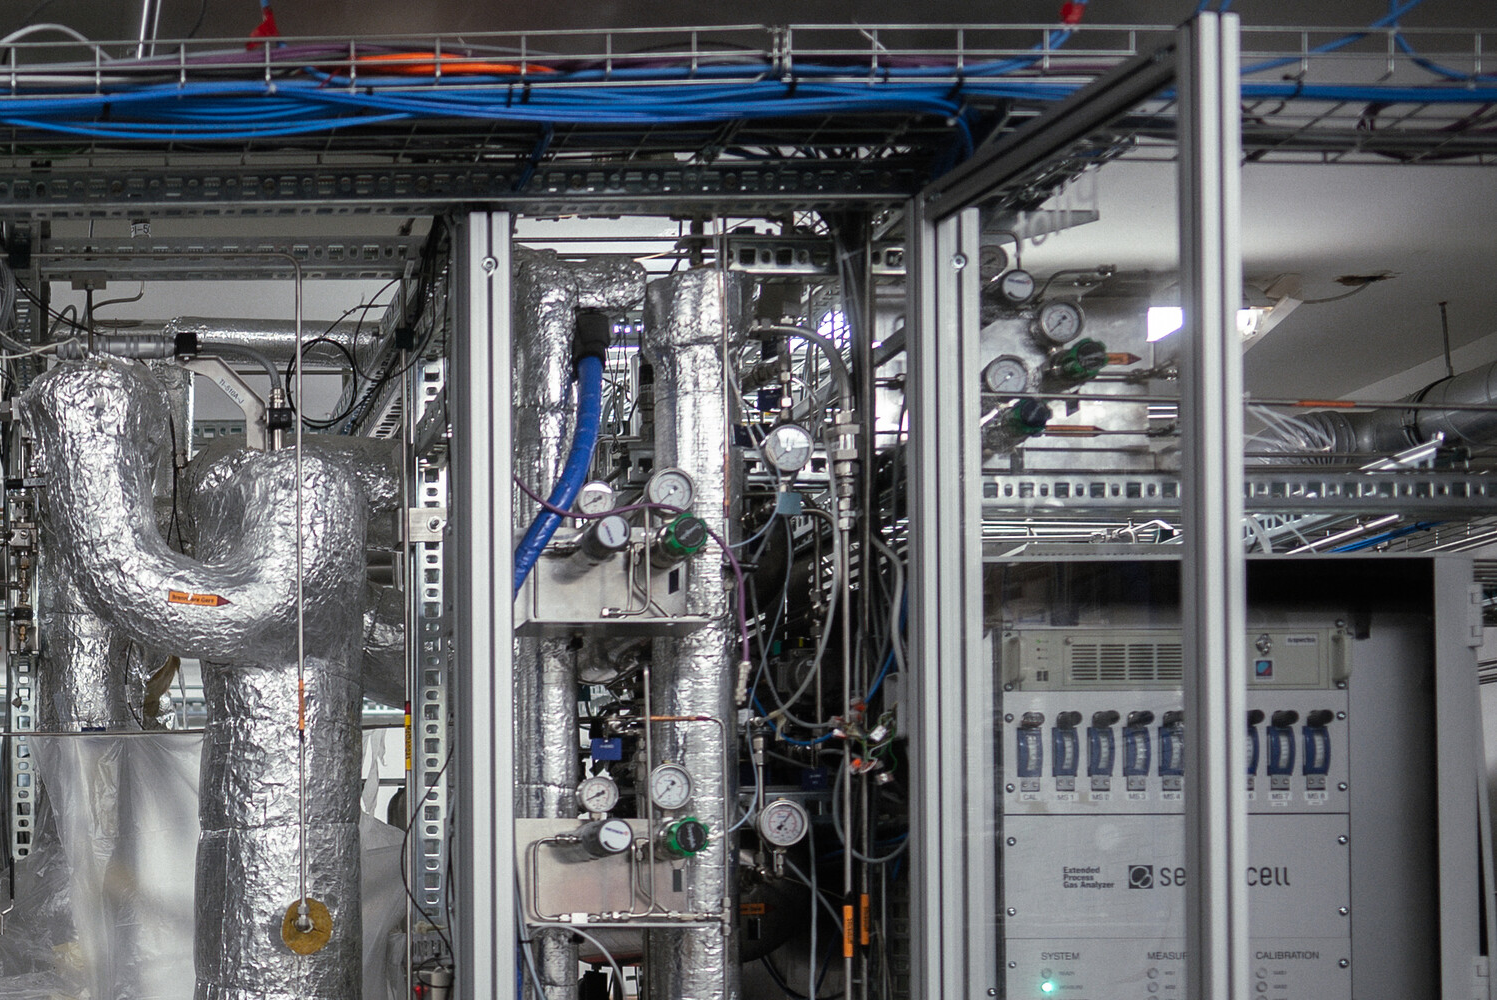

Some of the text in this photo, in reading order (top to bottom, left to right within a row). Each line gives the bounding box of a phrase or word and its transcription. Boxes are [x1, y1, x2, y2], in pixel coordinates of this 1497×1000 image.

[1063, 866, 1100, 874] Extended
[1063, 881, 1115, 890] Gas Analyzer
[1041, 952, 1080, 960] SYSTEM
[1255, 951, 1320, 960] CALIBRATION
